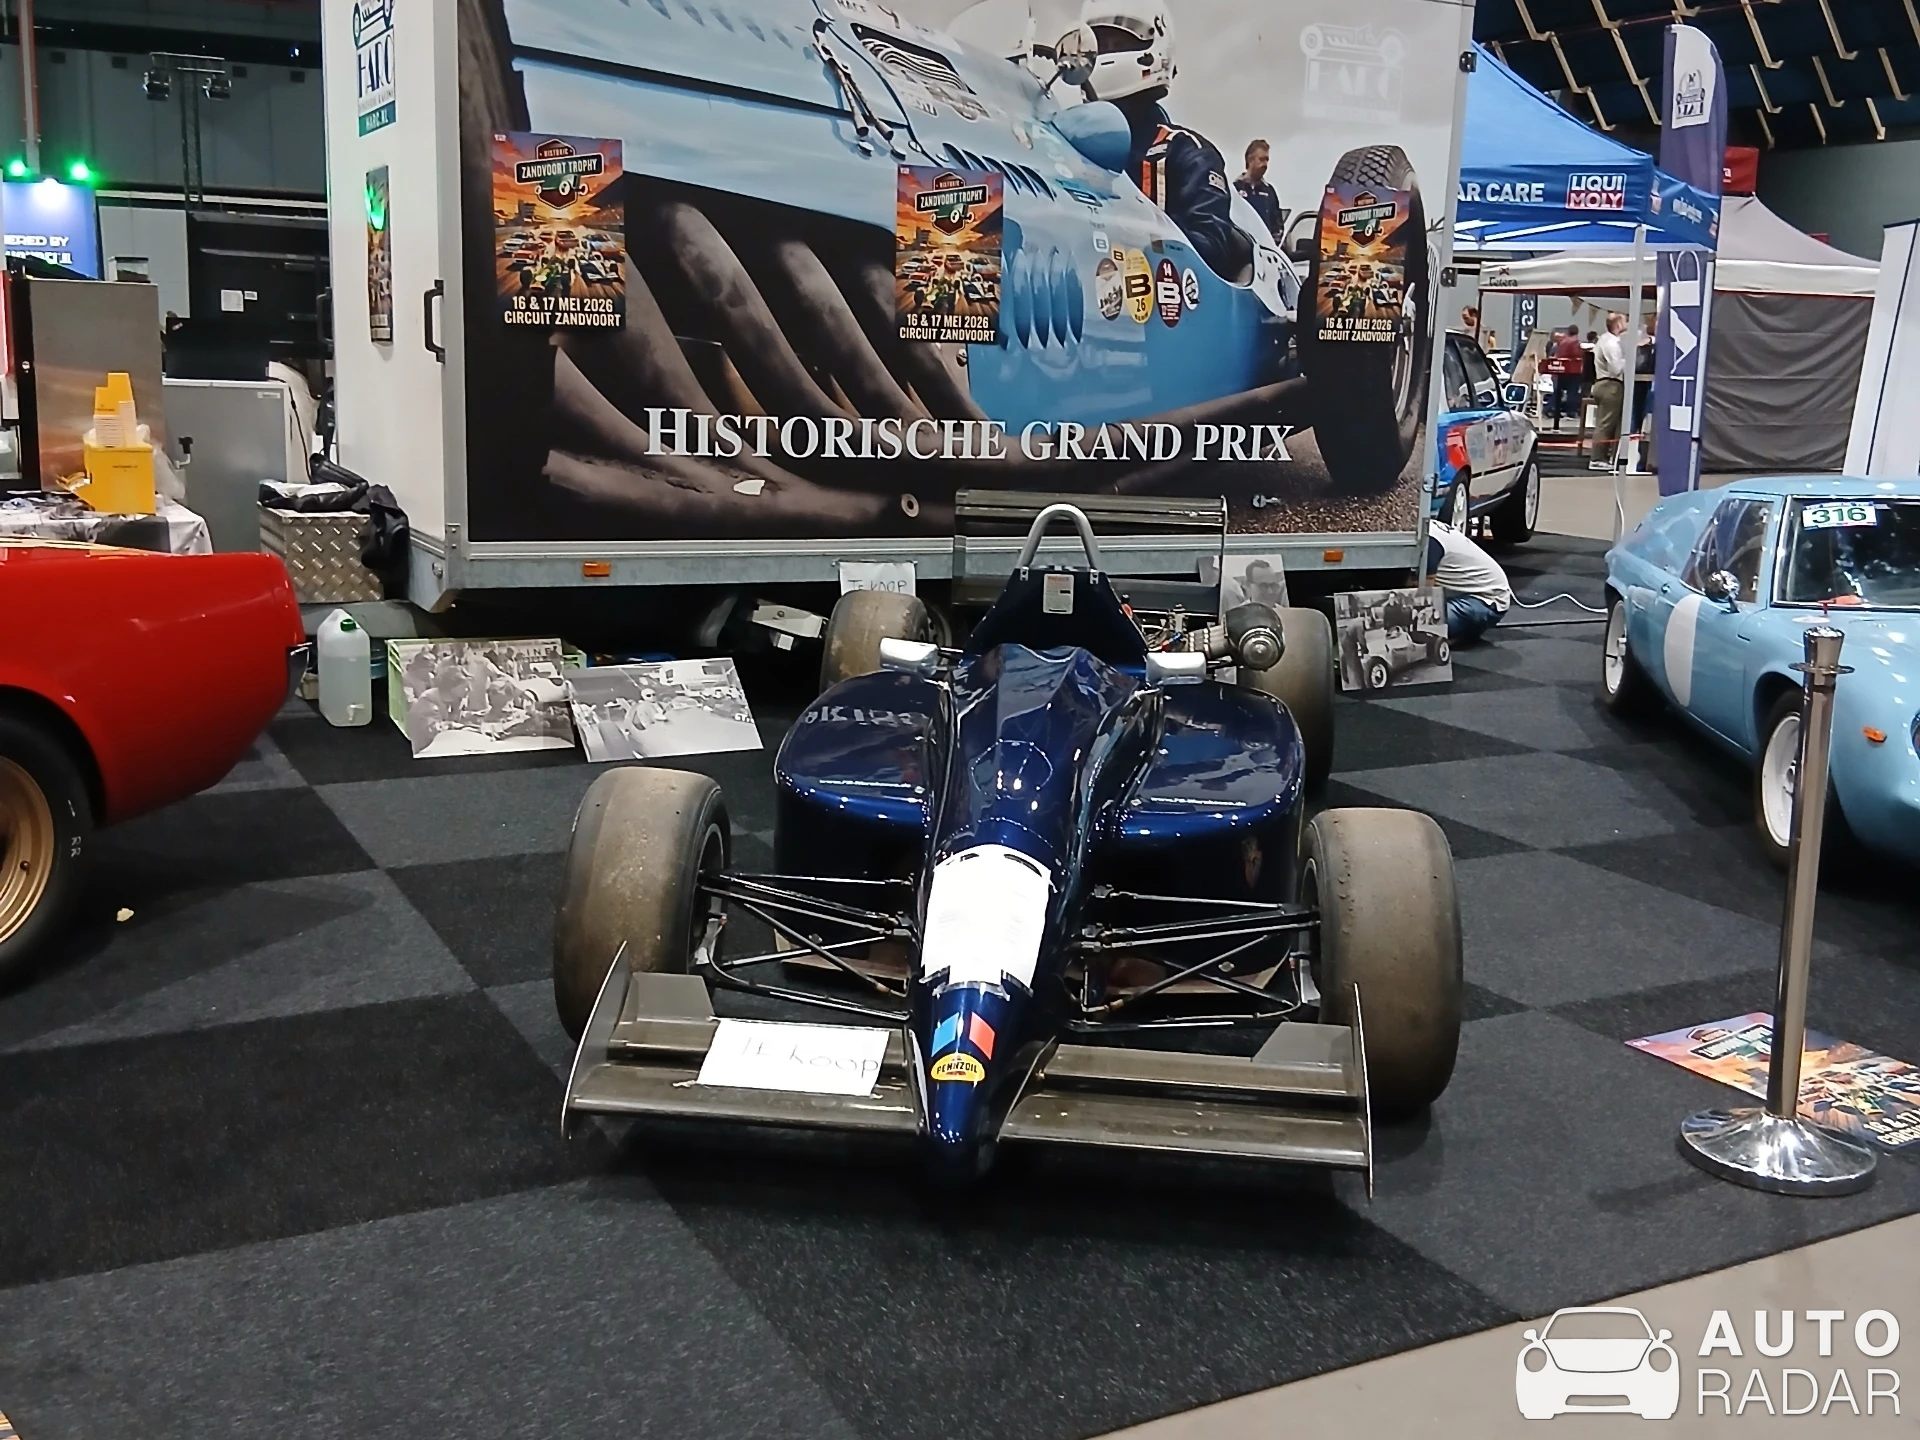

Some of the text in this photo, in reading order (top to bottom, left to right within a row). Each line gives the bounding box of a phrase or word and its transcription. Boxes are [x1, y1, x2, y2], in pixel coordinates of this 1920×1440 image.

[544, 148, 569, 158] HISTORIC
[521, 158, 598, 179] ZANDVOORT TROPHY
[1571, 175, 1623, 191] LIQUI
[920, 189, 983, 208] ZANDVOORT TROPHY
[1486, 183, 1545, 202] CARE
[1568, 192, 1623, 208] MOLY
[49, 236, 70, 247] BY
[1125, 274, 1151, 299] B
[1157, 282, 1180, 304] B
[512, 296, 613, 313] 16 & 17 MEI 2026
[504, 311, 622, 327] CIRCUIT ZANDVOORT
[907, 314, 989, 329] 16 & 17 MEI 2026
[1326, 317, 1393, 331] 16 & 17 MEI 2026
[899, 327, 996, 342] CIRCUIT ZANDVOORT
[1318, 329, 1397, 342] CIRCUIT ZANDVOORT
[643, 407, 1295, 462] HISTORISCHE GRAND PRIX
[1812, 507, 1867, 523] 316
[936, 1061, 978, 1075] PENNZOIL
